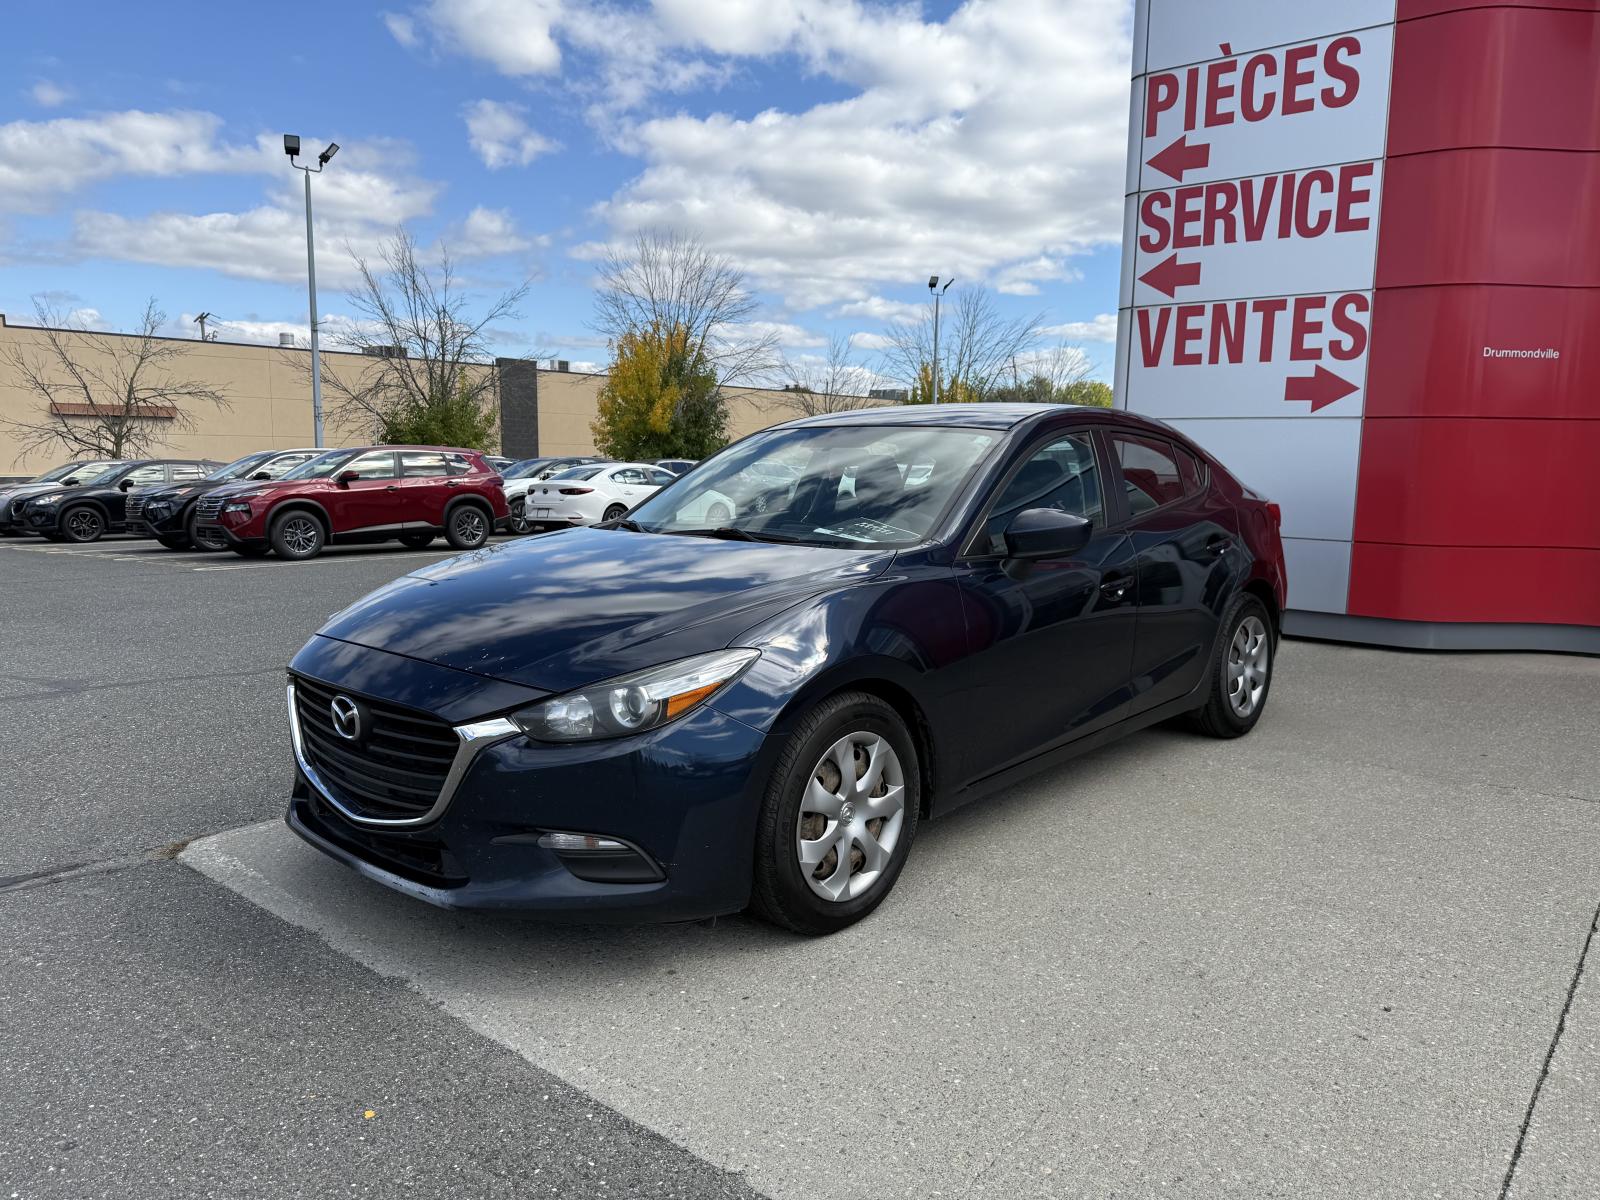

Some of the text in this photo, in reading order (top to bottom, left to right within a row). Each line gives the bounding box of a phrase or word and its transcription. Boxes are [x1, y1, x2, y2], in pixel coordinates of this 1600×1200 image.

[1145, 37, 1361, 138] PIÈCES
[1139, 162, 1374, 253] SERVICE
[1137, 293, 1370, 368] VENTES
[1483, 346, 1560, 359] Drummondville
